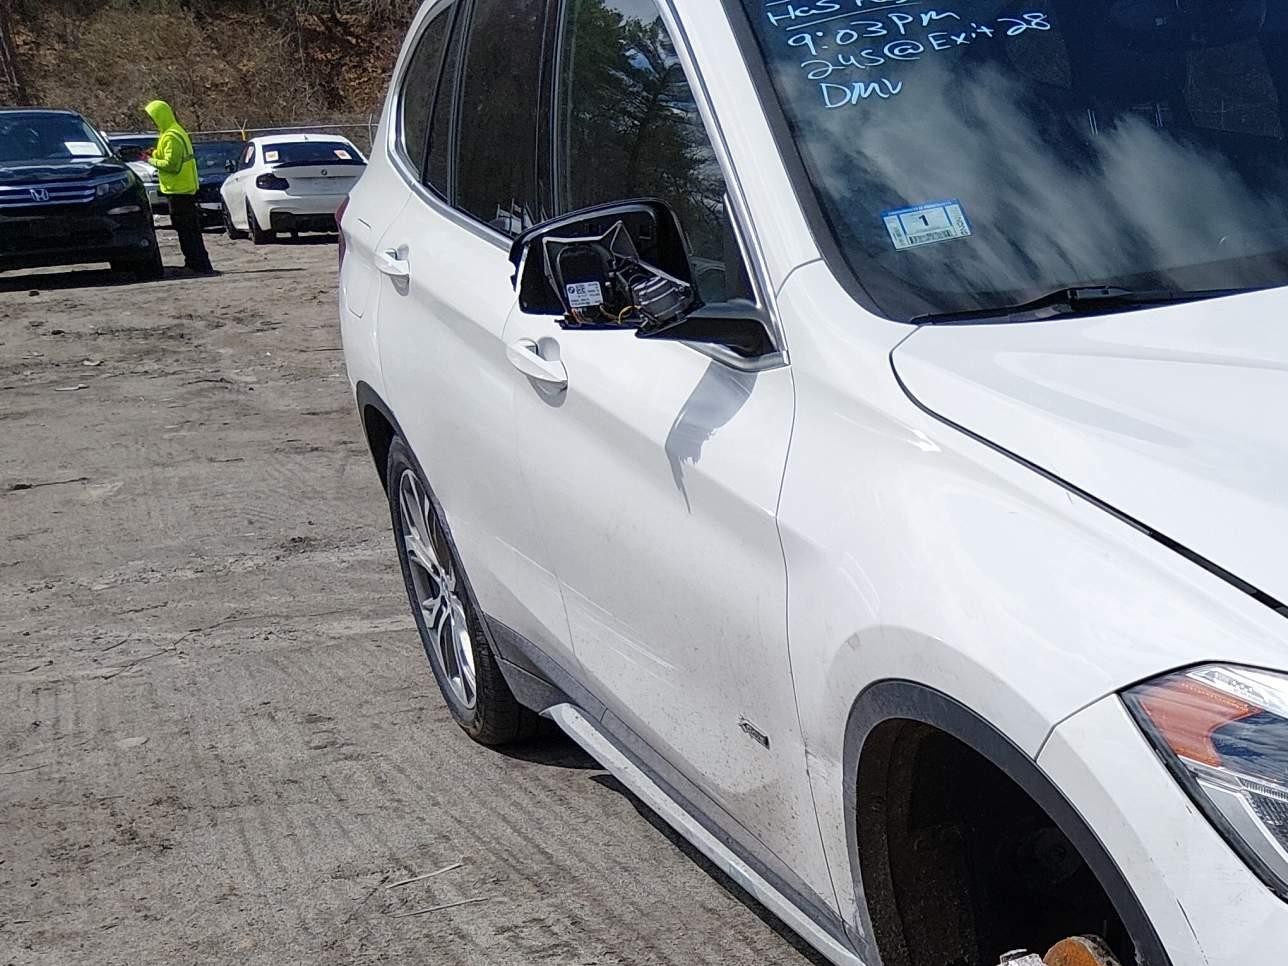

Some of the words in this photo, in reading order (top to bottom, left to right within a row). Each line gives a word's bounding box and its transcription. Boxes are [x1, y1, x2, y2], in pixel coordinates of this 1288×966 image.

[997, 13, 1050, 35] 28
[788, 21, 887, 55] 9:03
[918, 214, 929, 226] 1
